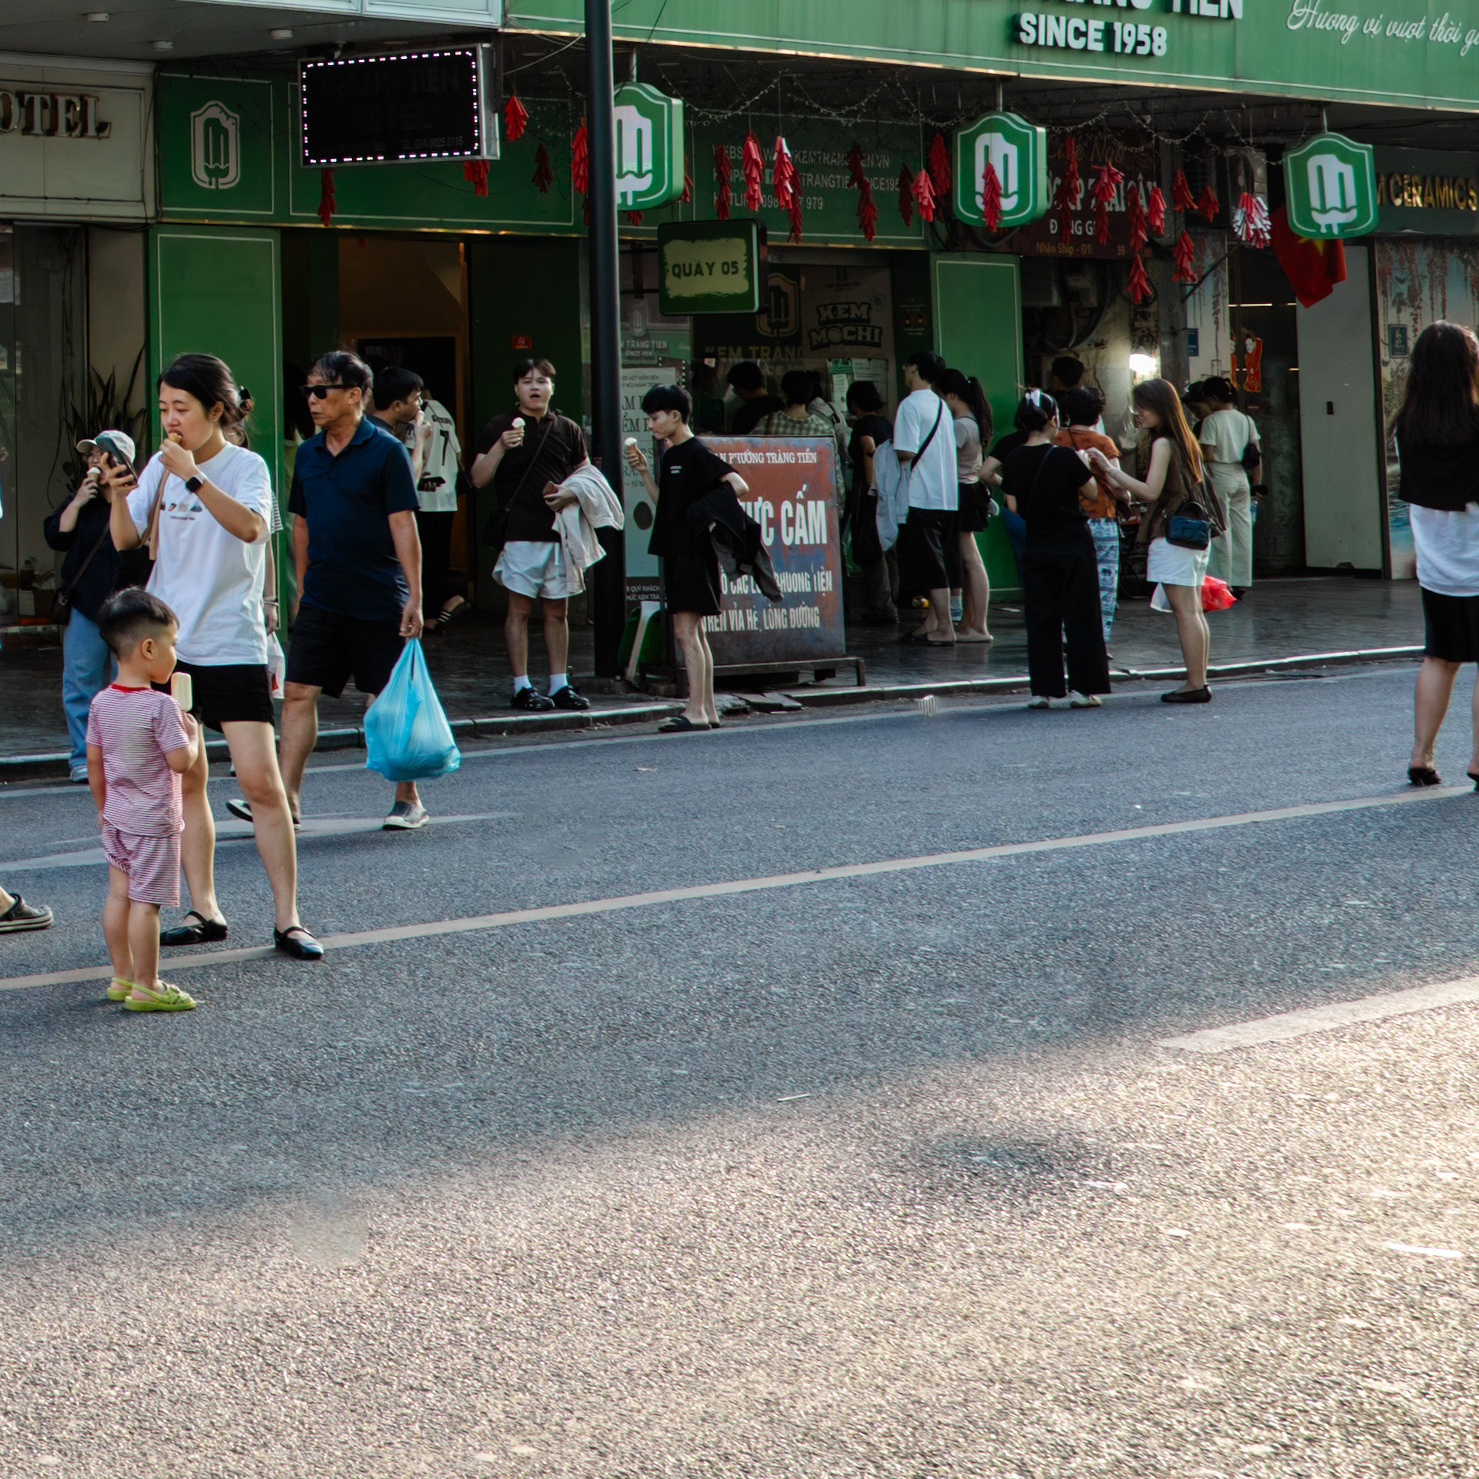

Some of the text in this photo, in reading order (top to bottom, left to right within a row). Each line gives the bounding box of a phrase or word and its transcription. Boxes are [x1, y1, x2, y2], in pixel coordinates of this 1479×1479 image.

[1016, 12, 1168, 57] SINCE 1958
[1362, 13, 1384, 39] vị
[1385, 15, 1427, 43] vượt
[1428, 12, 1462, 43] thời
[1388, 172, 1479, 212] CERAMICS
[721, 260, 739, 276] 05
[817, 302, 871, 325] KEM
[808, 324, 883, 351] MOCHI
[780, 484, 828, 546] CẤM
